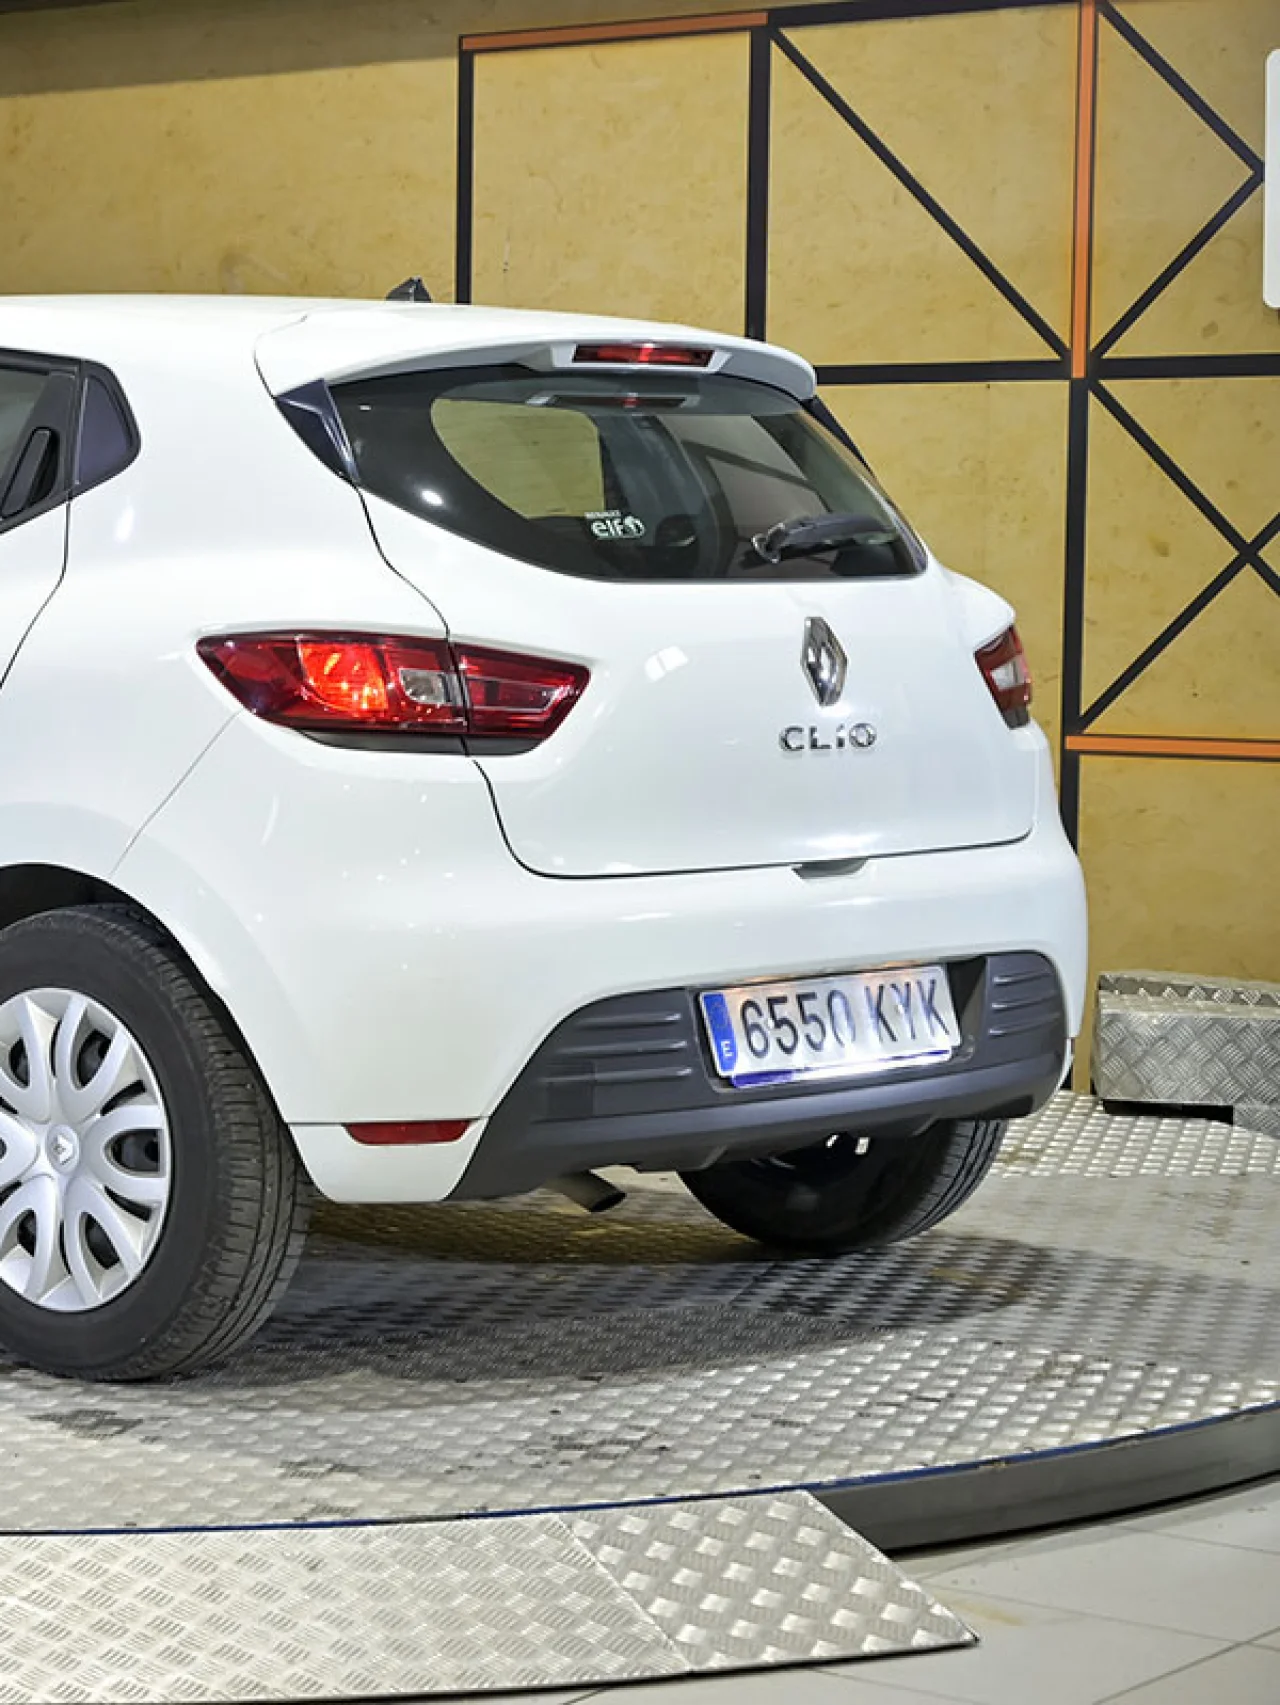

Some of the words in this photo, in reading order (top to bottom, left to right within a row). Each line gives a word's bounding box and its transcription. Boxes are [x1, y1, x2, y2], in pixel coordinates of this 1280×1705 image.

[740, 988, 856, 1060] 6550
[865, 979, 950, 1043] KYK
[721, 1040, 732, 1057] E
